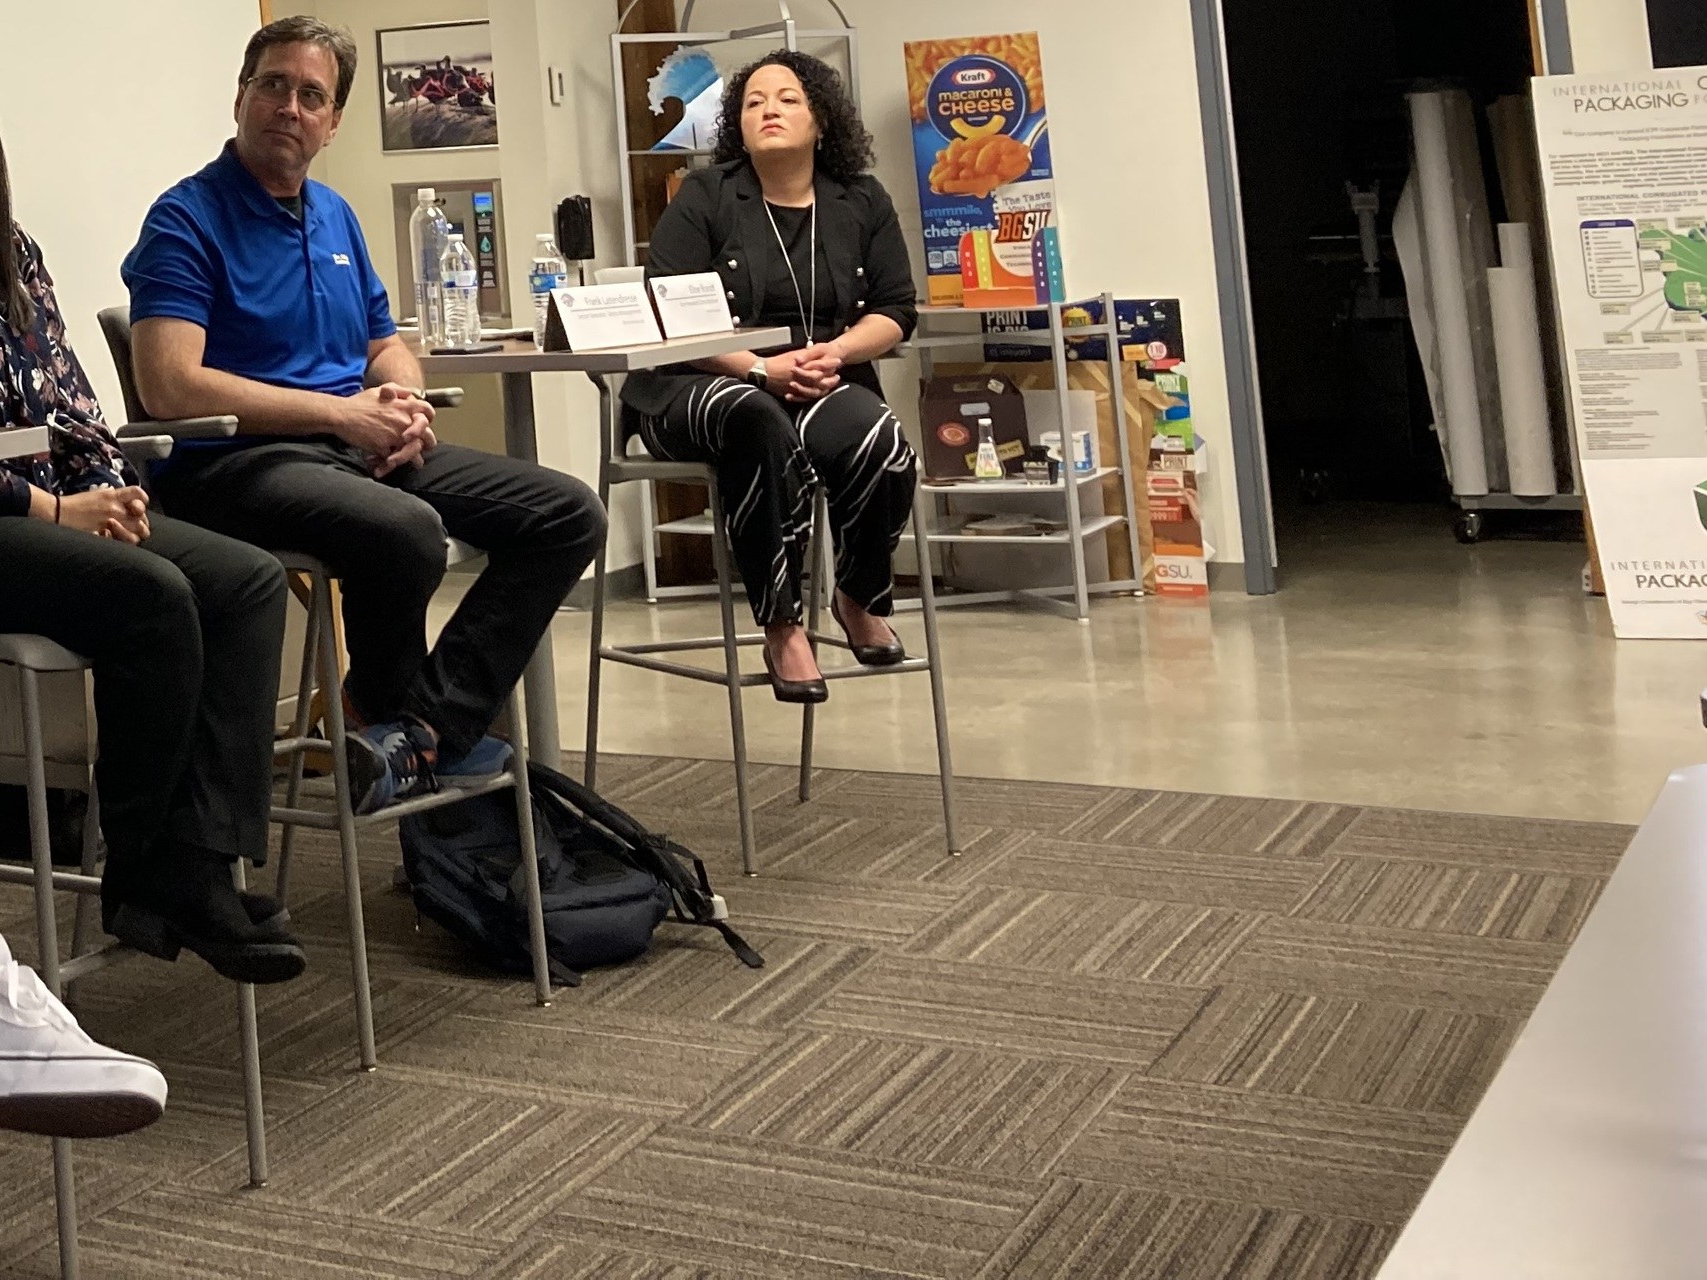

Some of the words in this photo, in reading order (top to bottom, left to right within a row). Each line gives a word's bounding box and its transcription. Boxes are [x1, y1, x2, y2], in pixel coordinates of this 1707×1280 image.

[960, 72, 986, 82] Kraft
[938, 87, 1002, 101] macaroni
[1004, 87, 1013, 97] &
[1553, 80, 1682, 97] INTERNATIONAL
[1574, 93, 1689, 112] PACKAGING
[1003, 196, 1022, 206] The
[1023, 191, 1052, 202] Taste
[945, 218, 962, 228] the
[995, 209, 1052, 243] BGSU
[986, 311, 1028, 326] PRINT
